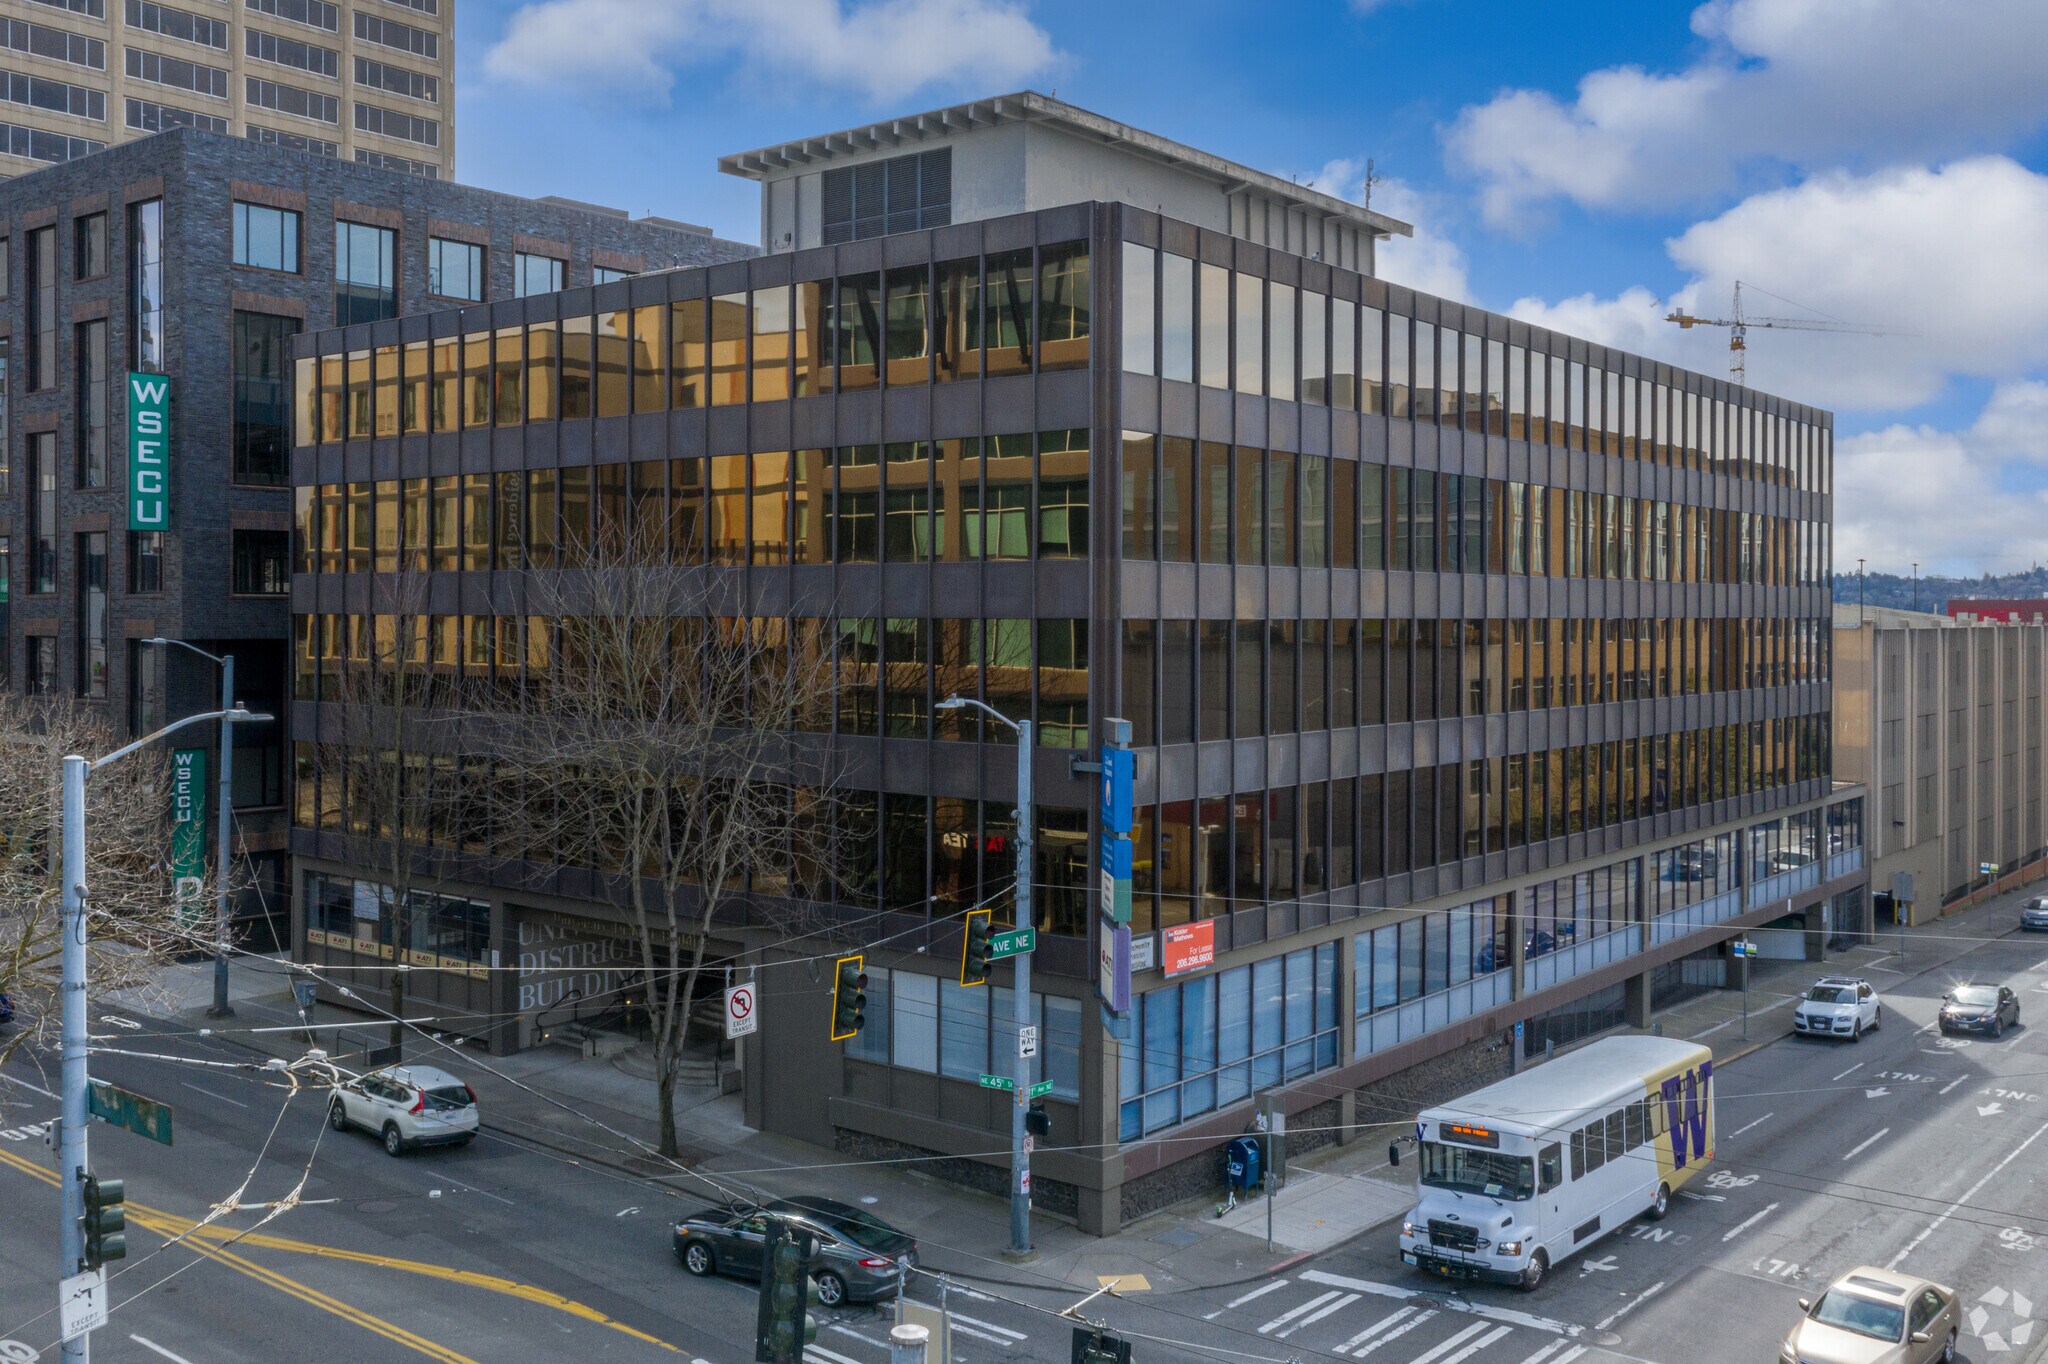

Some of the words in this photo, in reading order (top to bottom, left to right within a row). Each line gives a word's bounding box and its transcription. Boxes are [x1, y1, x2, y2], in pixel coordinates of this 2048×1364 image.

[132, 380, 167, 523] WSECU
[175, 753, 193, 822] WSECU
[993, 940, 1010, 952] AVE
[1015, 934, 1029, 948] NE
[1199, 945, 1213, 953] Lease
[732, 1024, 752, 1034] TRANSIT
[733, 1018, 751, 1028] EXCEPT
[1021, 1028, 1035, 1038] ONE
[1021, 1037, 1035, 1046] WAY
[981, 1077, 988, 1085] NE
[1873, 1070, 1935, 1083] ONLY
[1978, 1087, 2041, 1102] ONLY
[1661, 1061, 1712, 1171] W
[70, 1319, 100, 1335] TRANSIT
[71, 1312, 98, 1329] EXCEPT
